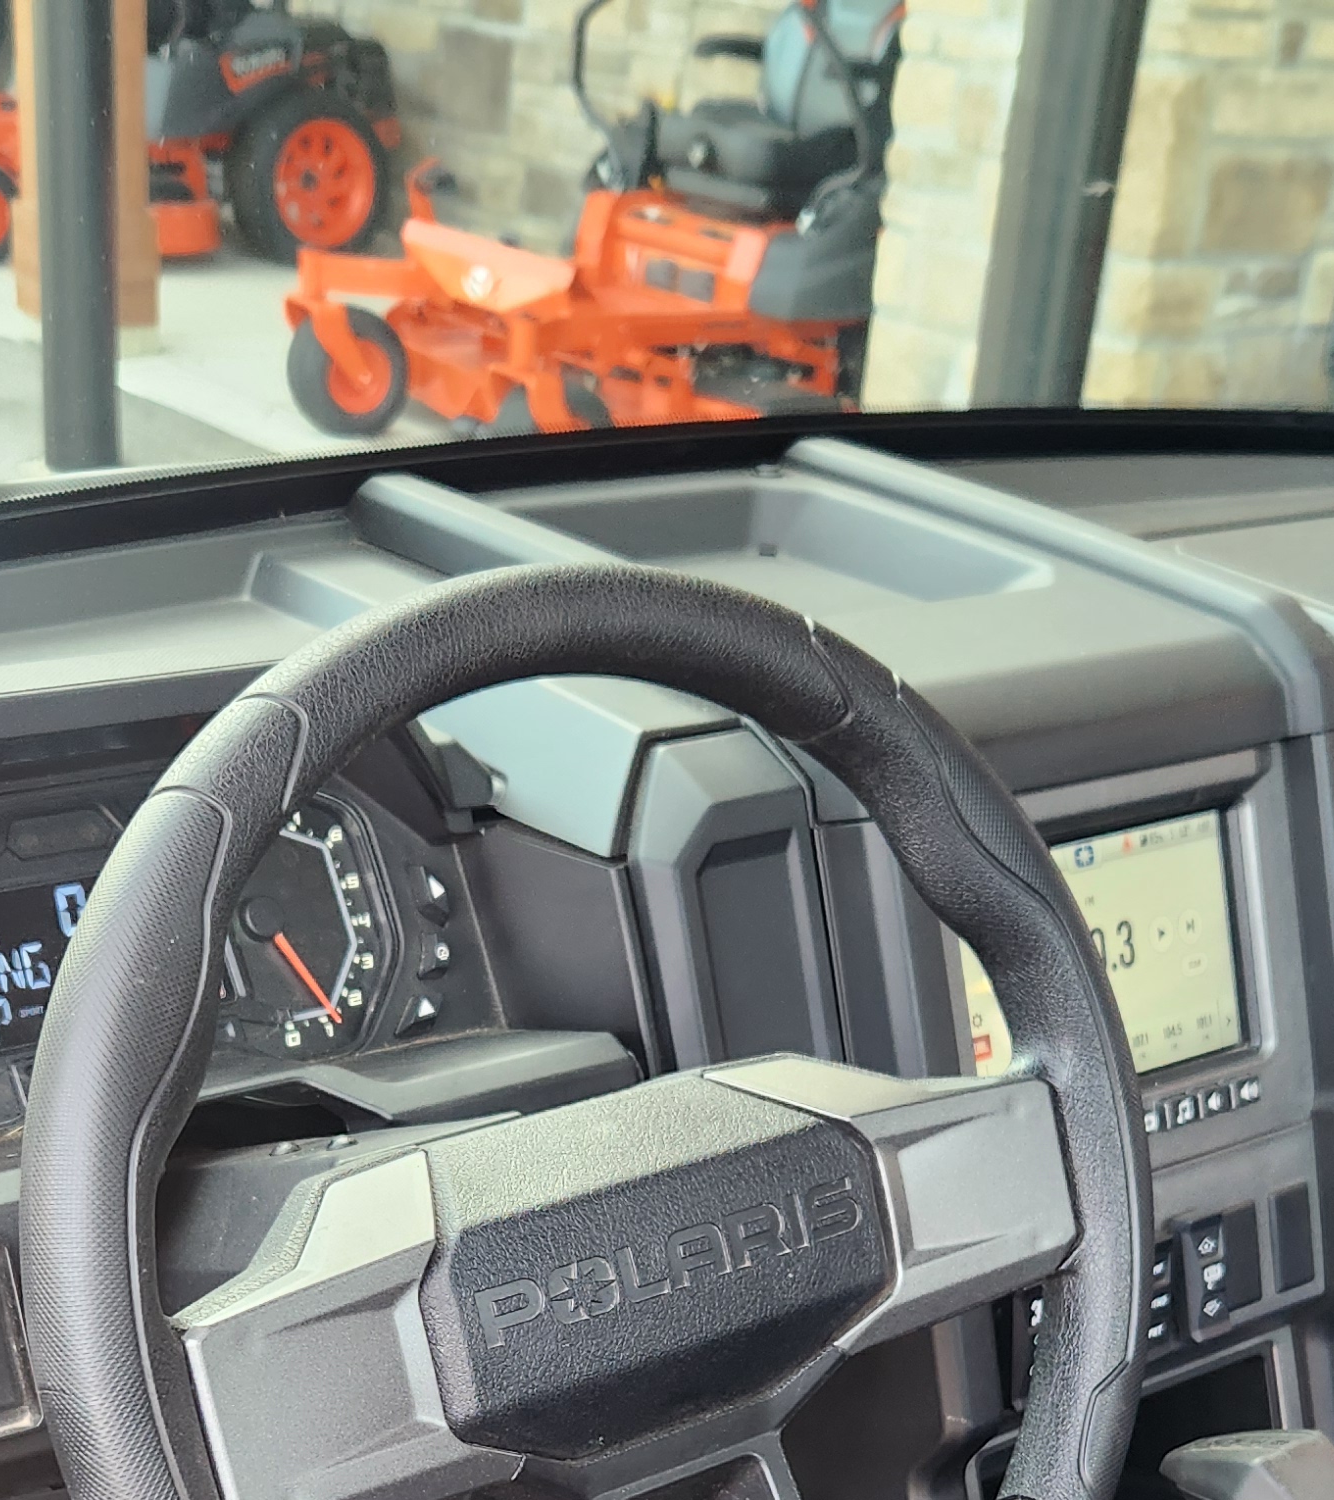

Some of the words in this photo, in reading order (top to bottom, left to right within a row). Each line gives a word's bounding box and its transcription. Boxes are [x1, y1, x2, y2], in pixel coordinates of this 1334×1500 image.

[344, 873, 360, 889] 5
[359, 952, 374, 969] 3
[347, 989, 363, 1007] 2
[474, 1176, 864, 1350] POLARIS
